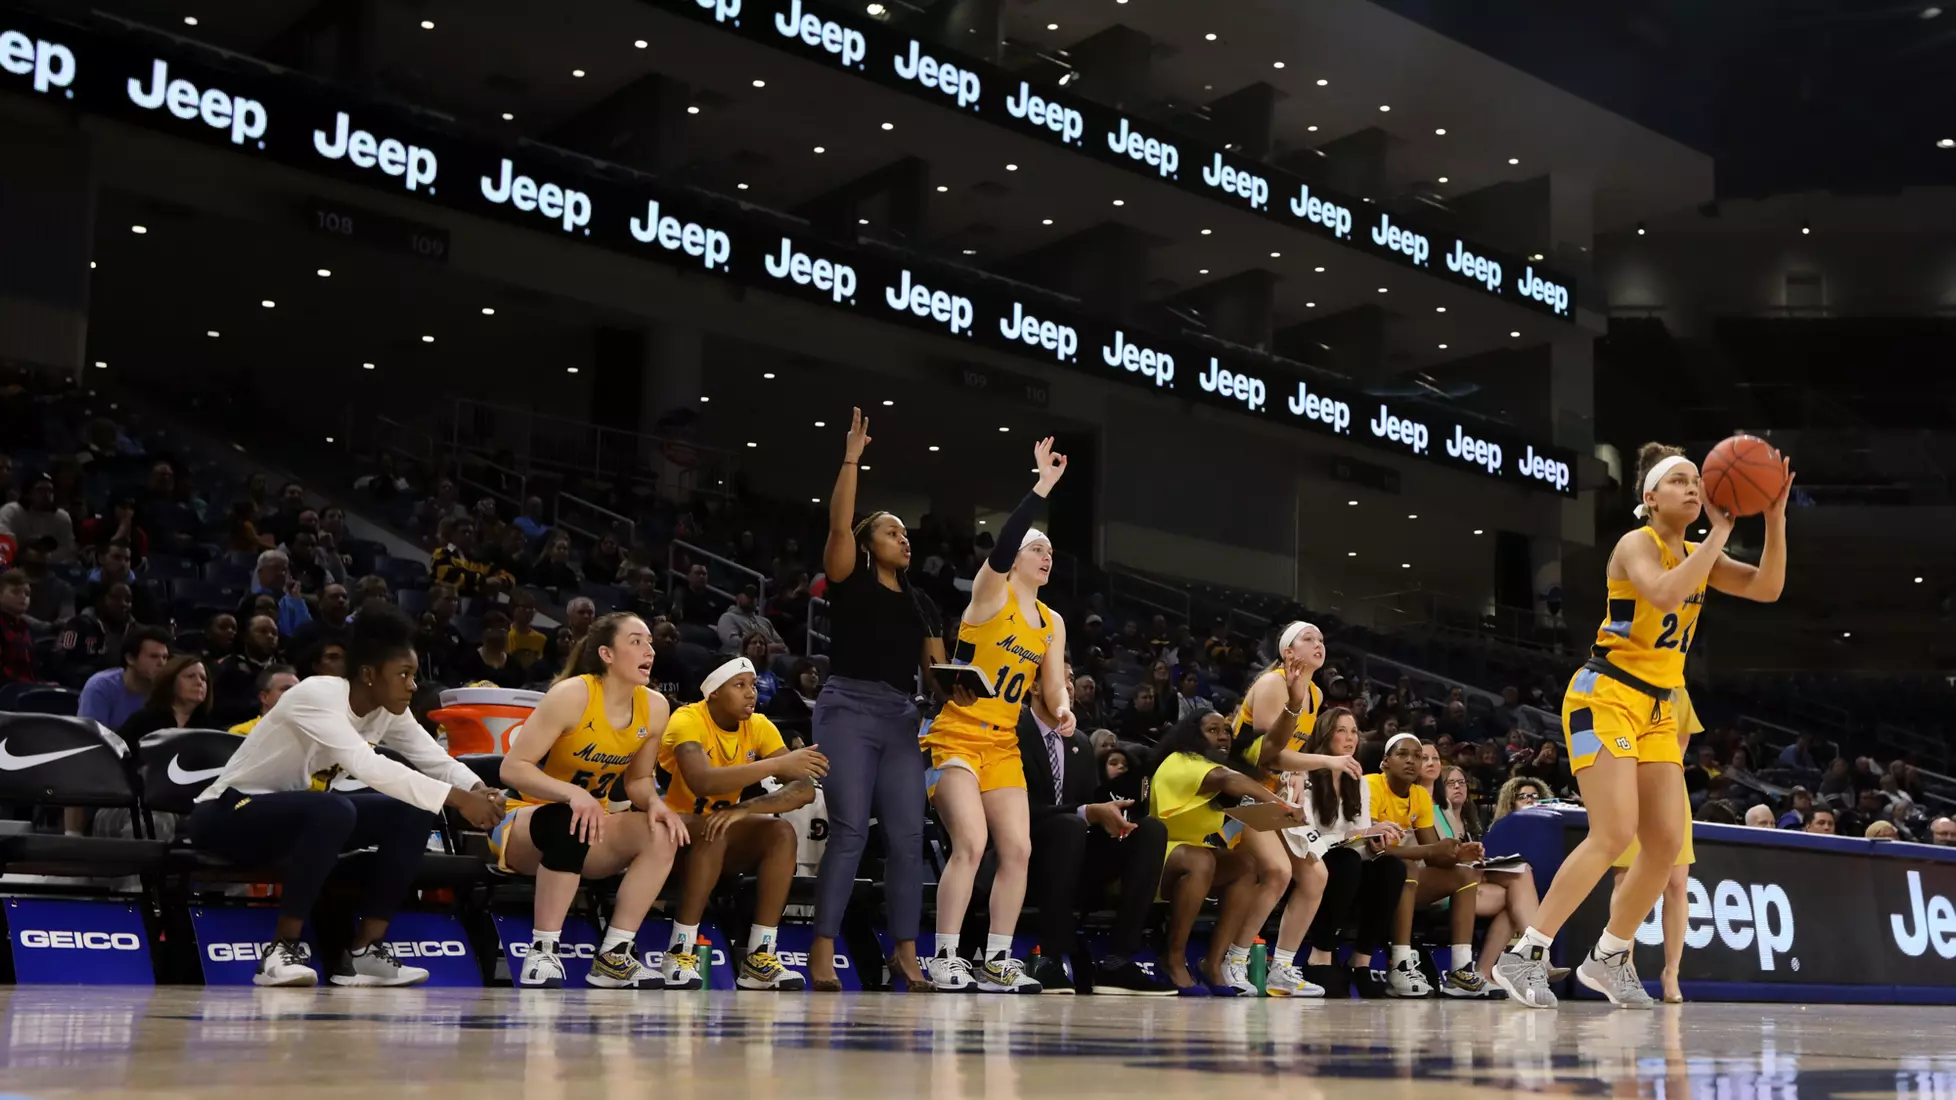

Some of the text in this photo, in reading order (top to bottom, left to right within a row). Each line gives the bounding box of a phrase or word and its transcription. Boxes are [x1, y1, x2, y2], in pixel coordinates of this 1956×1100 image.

[774, 0, 866, 70] Jeep
[894, 39, 981, 111] Jeep
[1006, 81, 1084, 147] Jeep
[1107, 118, 1179, 180] Jeep
[1202, 152, 1269, 212] Jeep
[1290, 184, 1352, 240] Jeep
[1371, 213, 1429, 267] Jeep
[1446, 239, 1502, 293] Jeep
[1517, 266, 1569, 316] Jeep
[127, 59, 268, 144] Jeep
[313, 111, 438, 195] Jeep
[480, 158, 592, 236] Jeep
[629, 199, 731, 273] Jeep
[764, 237, 857, 306] Jeep
[885, 269, 974, 337] Jeep
[999, 301, 1078, 363] Jeep
[1102, 330, 1175, 389] Jeep
[1199, 357, 1266, 413] Jeep
[1288, 381, 1351, 435] Jeep
[1370, 404, 1429, 455] Jeep
[1446, 424, 1502, 475] Jeep
[1518, 445, 1570, 492] Jeep
[993, 664, 1026, 703] 10
[19, 929, 141, 951] GEICO
[775, 950, 850, 969] GEO
